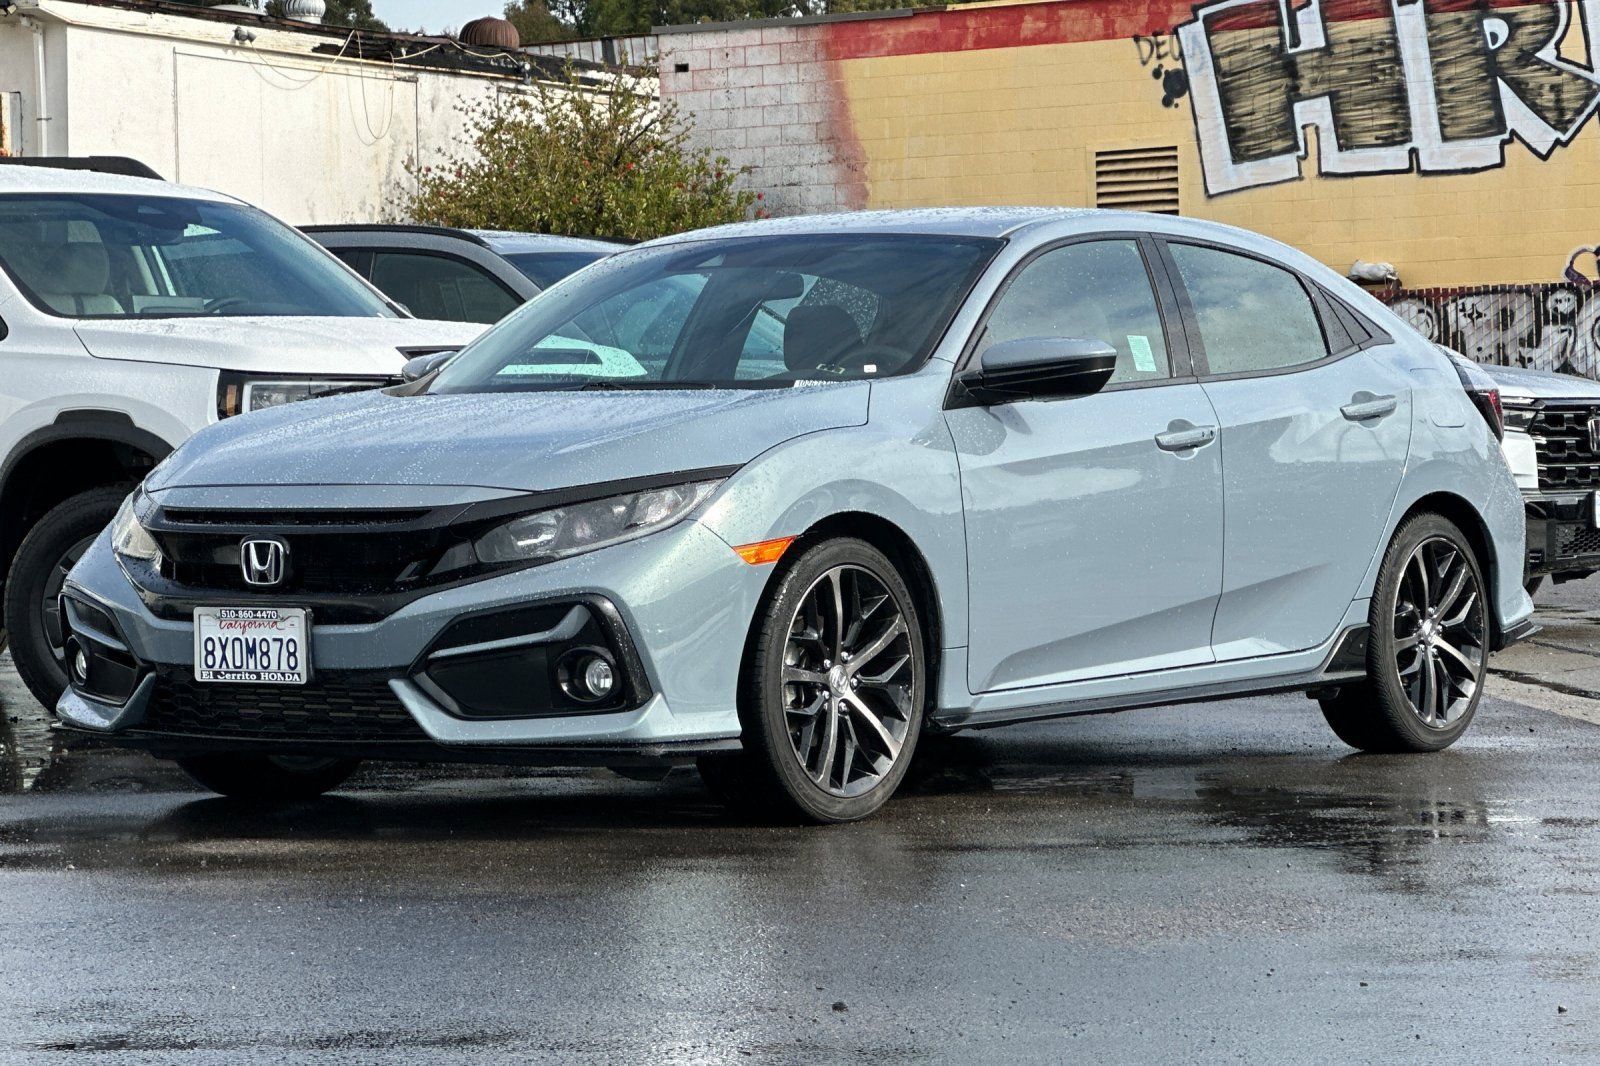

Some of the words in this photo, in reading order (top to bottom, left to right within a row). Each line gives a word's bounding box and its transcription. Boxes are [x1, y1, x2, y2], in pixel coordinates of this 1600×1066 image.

[221, 610, 278, 619] 510-860-4470
[219, 620, 285, 635] California
[202, 671, 213, 679] El
[217, 671, 257, 680] Cerrito
[260, 672, 300, 681] HONDA
